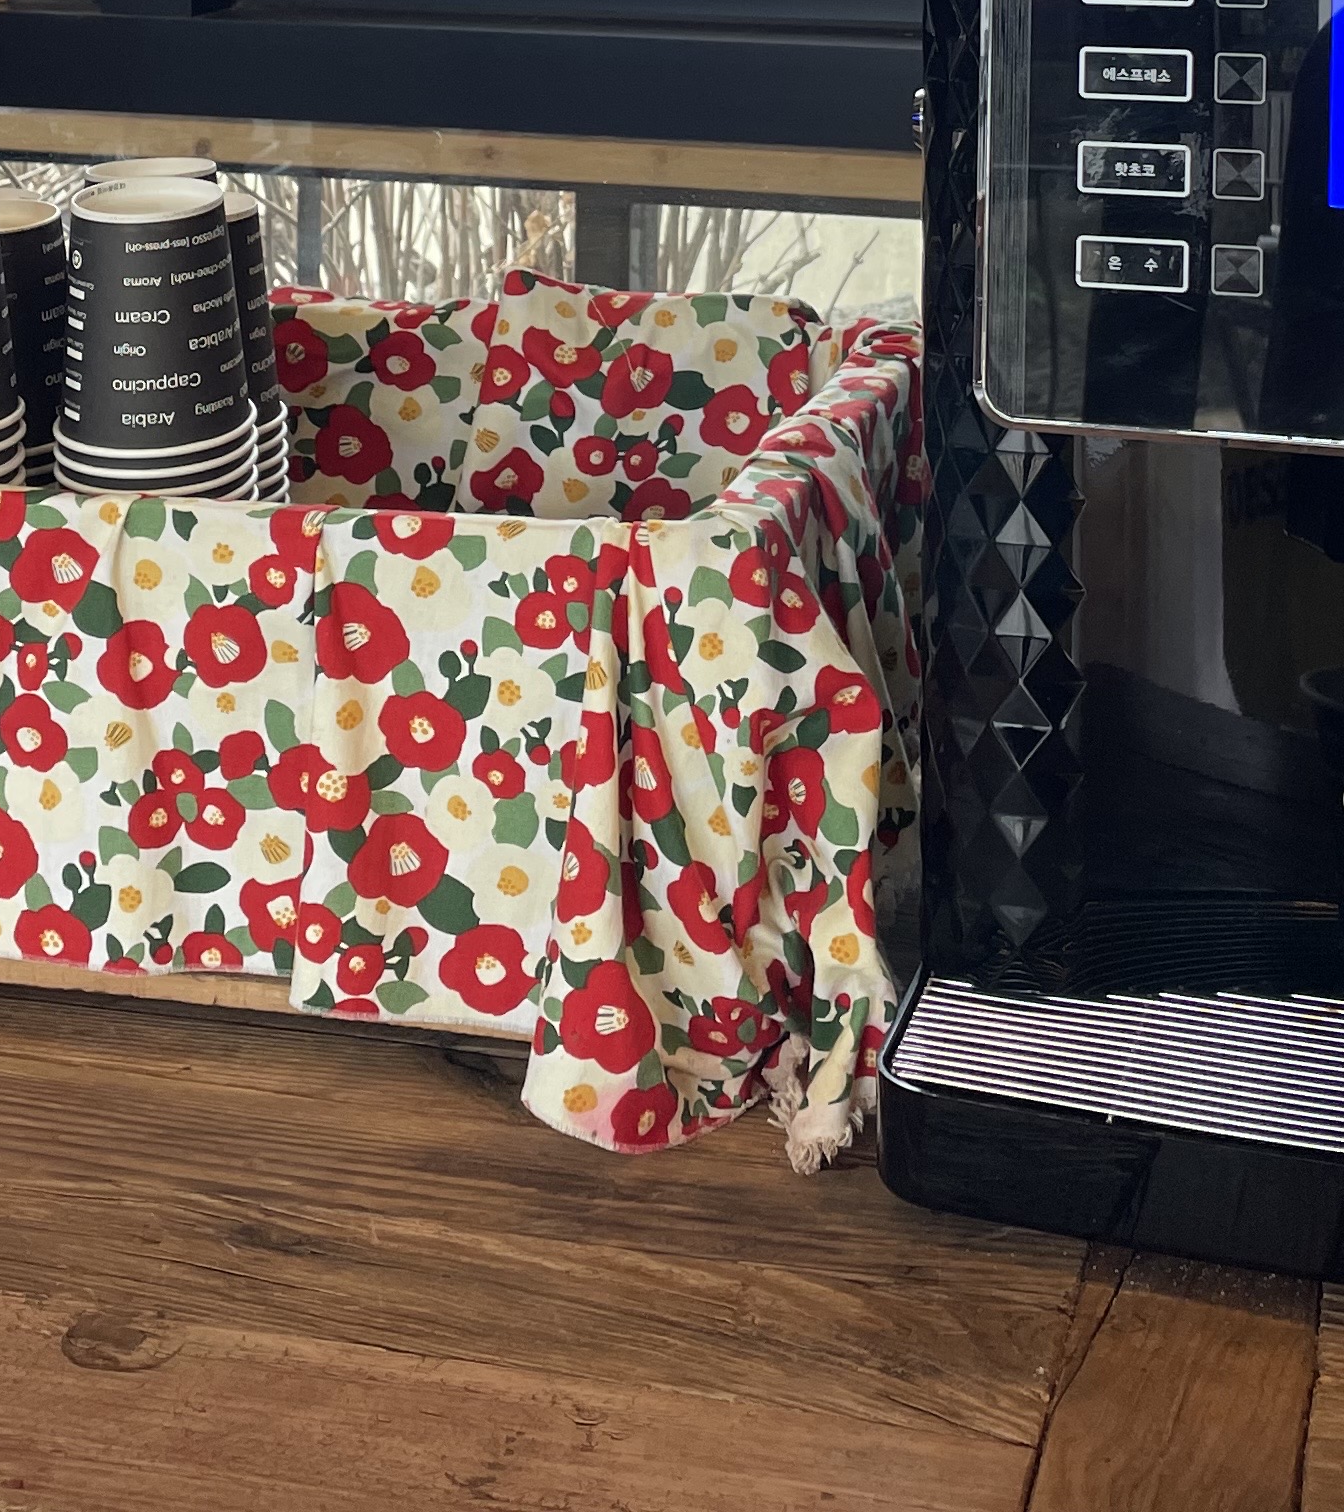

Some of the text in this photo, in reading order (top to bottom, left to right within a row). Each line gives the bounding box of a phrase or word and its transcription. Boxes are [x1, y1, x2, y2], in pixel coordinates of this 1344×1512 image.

[1101, 66, 1173, 85] 에스프레소
[1114, 161, 1157, 178] 핫초코
[123, 275, 162, 288] Aroma
[114, 309, 171, 325] Cream
[188, 325, 233, 350] Arabica
[113, 342, 147, 357] Origin
[111, 372, 202, 395] Cappucino
[194, 394, 234, 416] Roasting
[121, 410, 176, 428] Arabia
